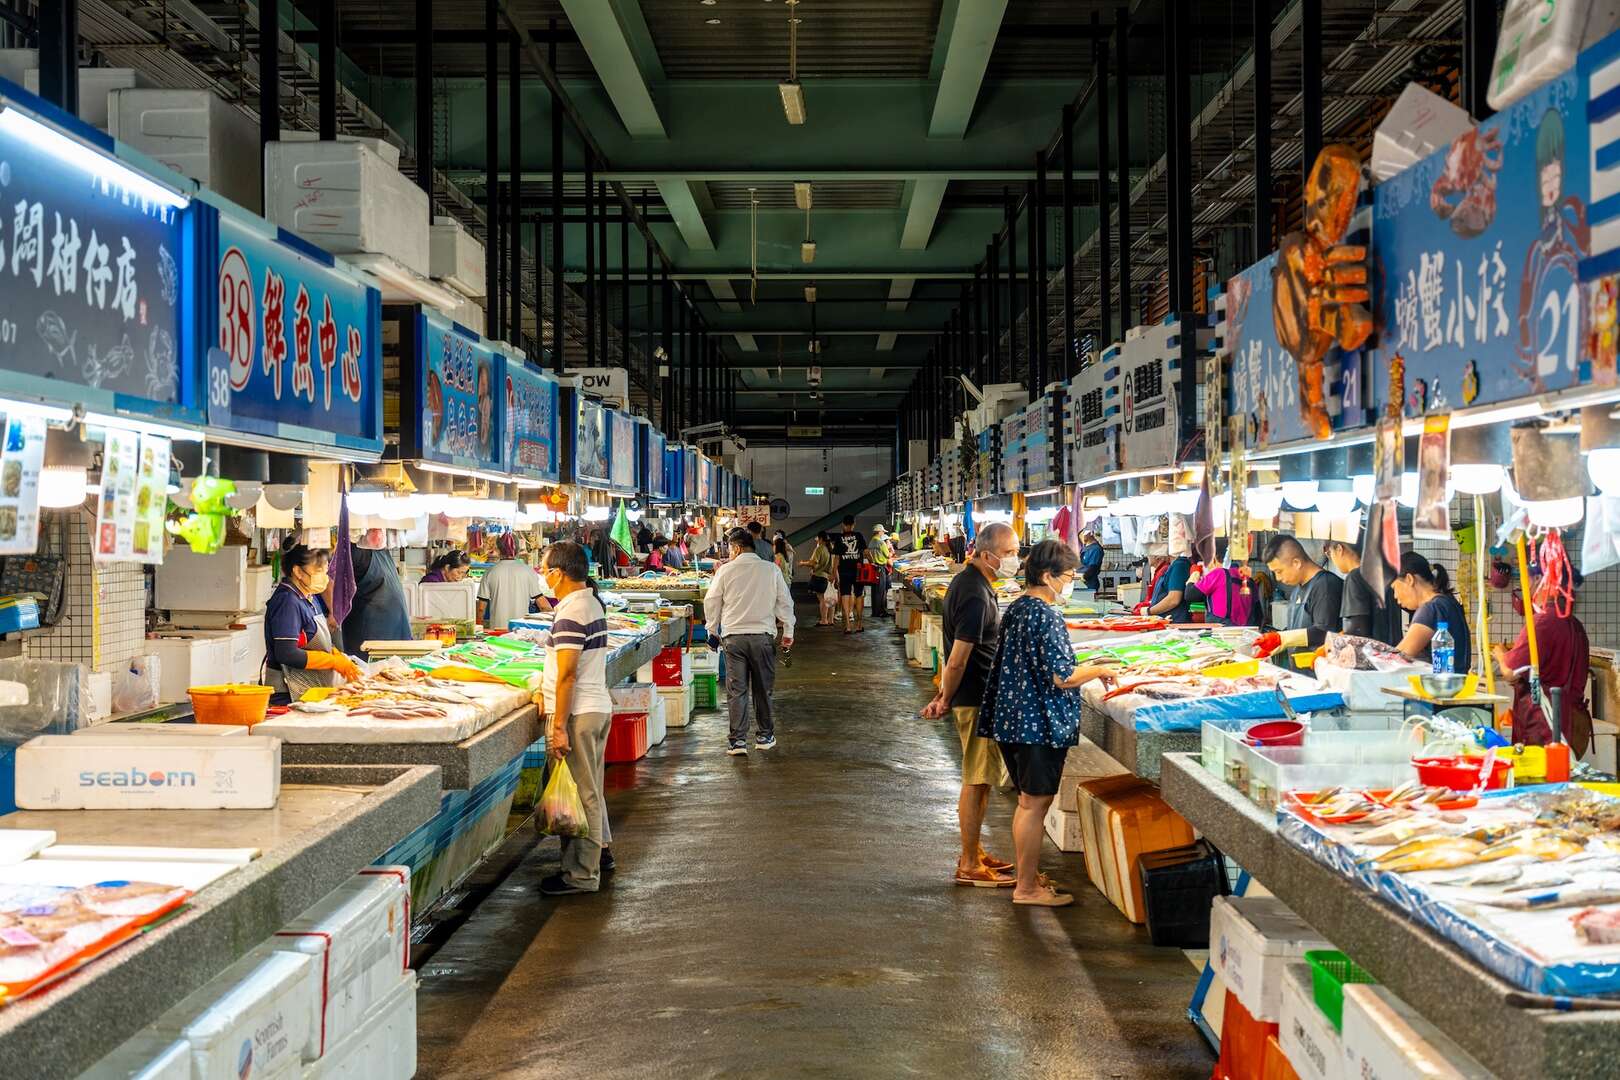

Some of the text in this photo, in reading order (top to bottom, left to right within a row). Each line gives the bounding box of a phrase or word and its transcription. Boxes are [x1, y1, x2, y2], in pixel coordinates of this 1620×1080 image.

[0, 199, 138, 323] 闆柑仔店
[221, 272, 252, 369] 38
[262, 265, 362, 411] 鮮魚中心
[1536, 283, 1580, 376] 21
[211, 365, 229, 407] 38
[1342, 367, 1357, 408] 21
[79, 767, 196, 787] seaborn
